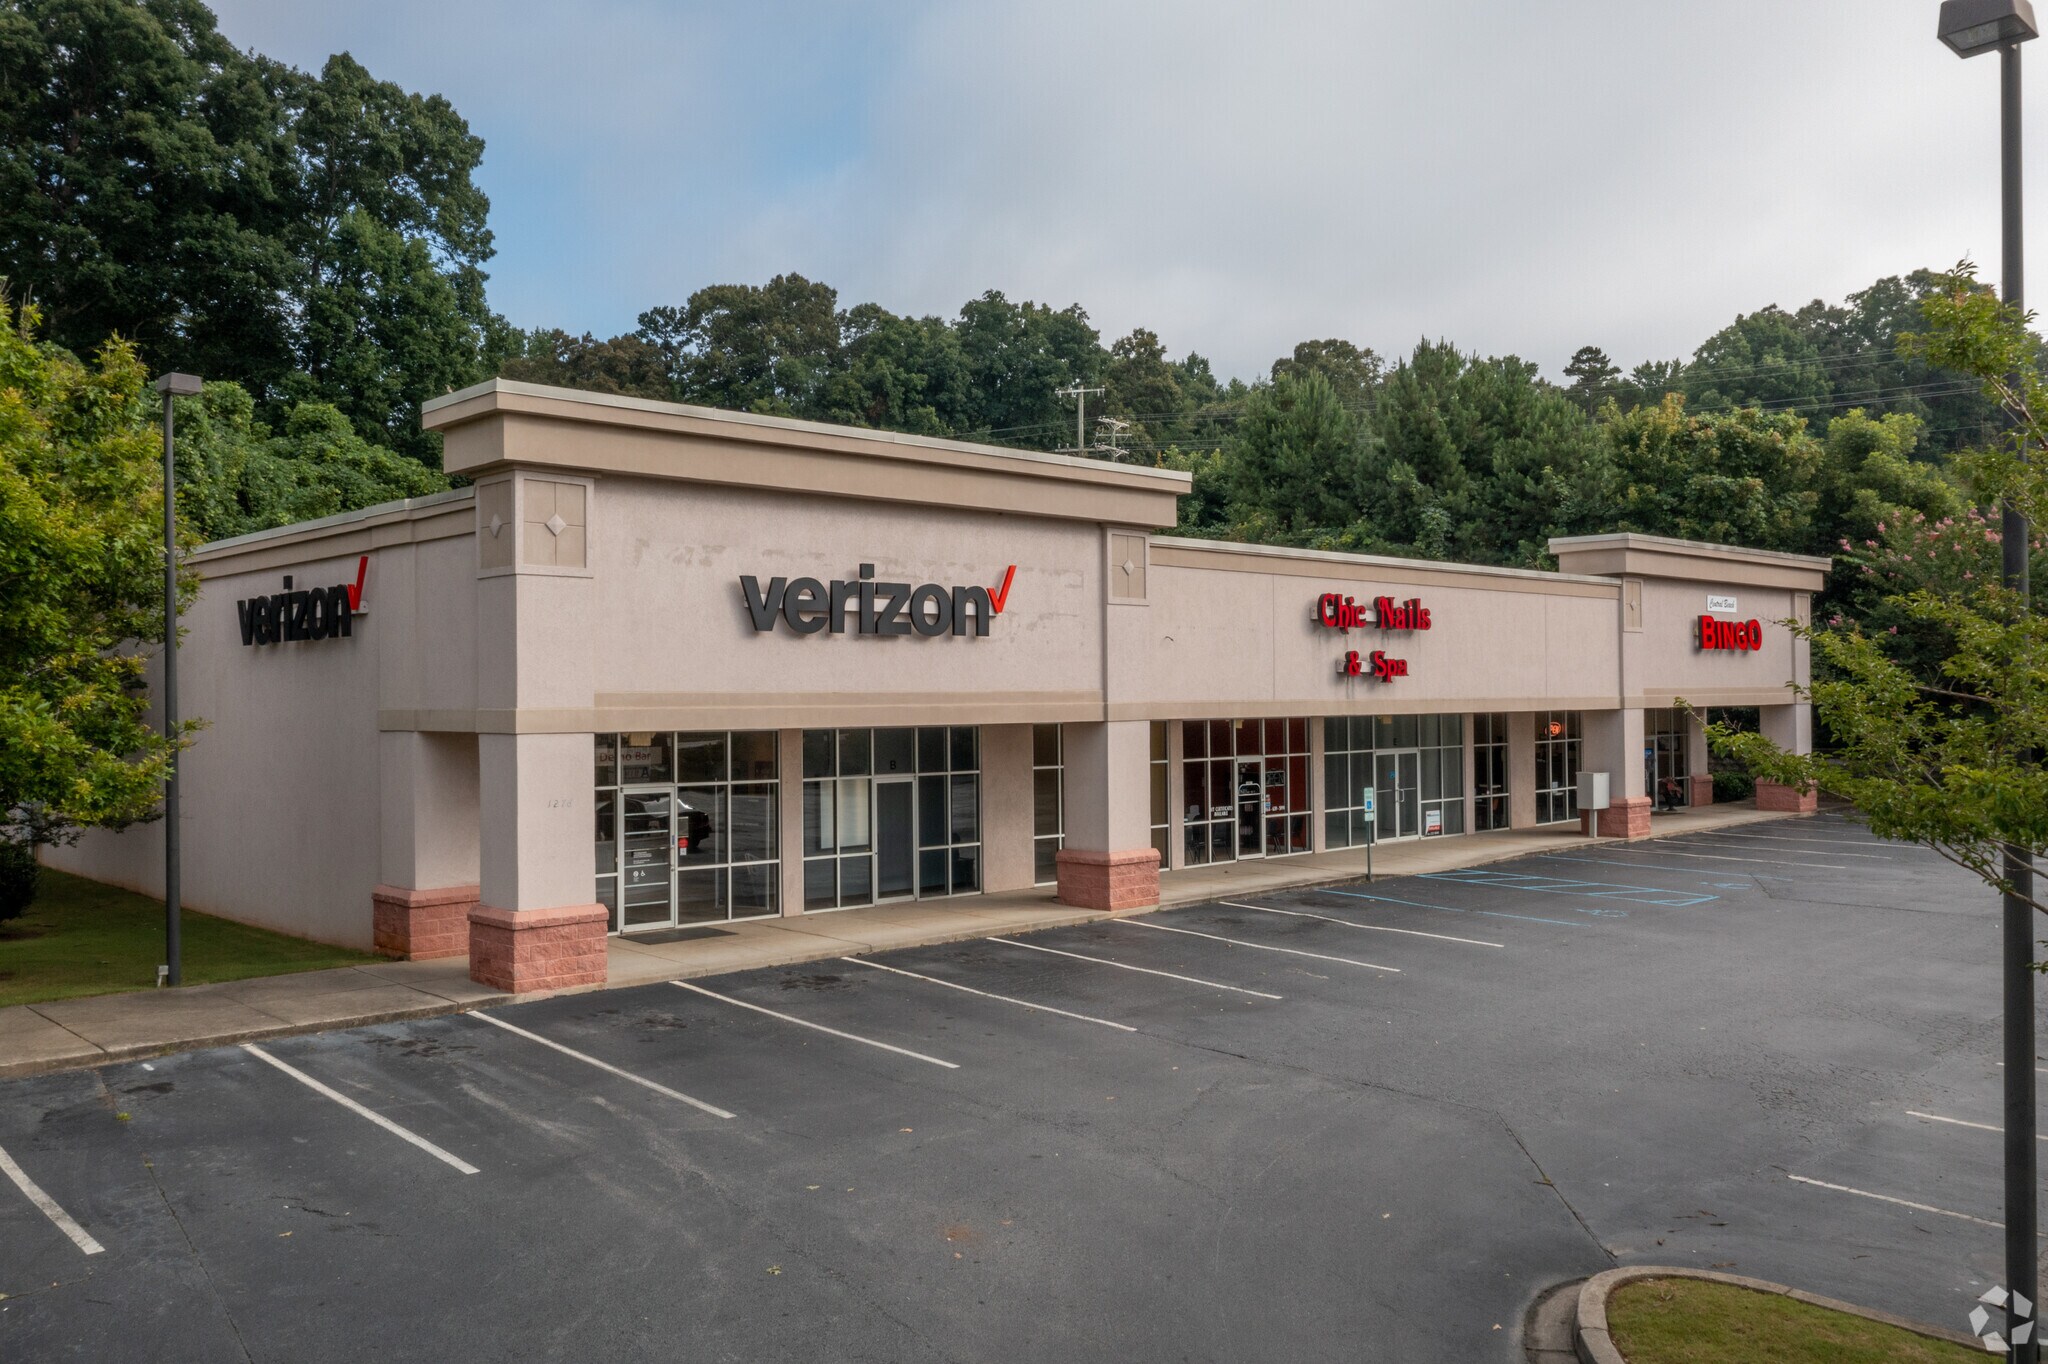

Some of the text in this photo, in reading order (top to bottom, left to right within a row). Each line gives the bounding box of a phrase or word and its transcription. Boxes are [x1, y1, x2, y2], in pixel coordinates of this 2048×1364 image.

[237, 575, 352, 646] verizon
[739, 563, 990, 637] verizon
[1317, 593, 1431, 634] Chic Nails
[1698, 615, 1762, 651] BINGO
[1343, 650, 1409, 683] & Spa
[600, 753, 632, 762] Deo
[890, 760, 897, 770] B
